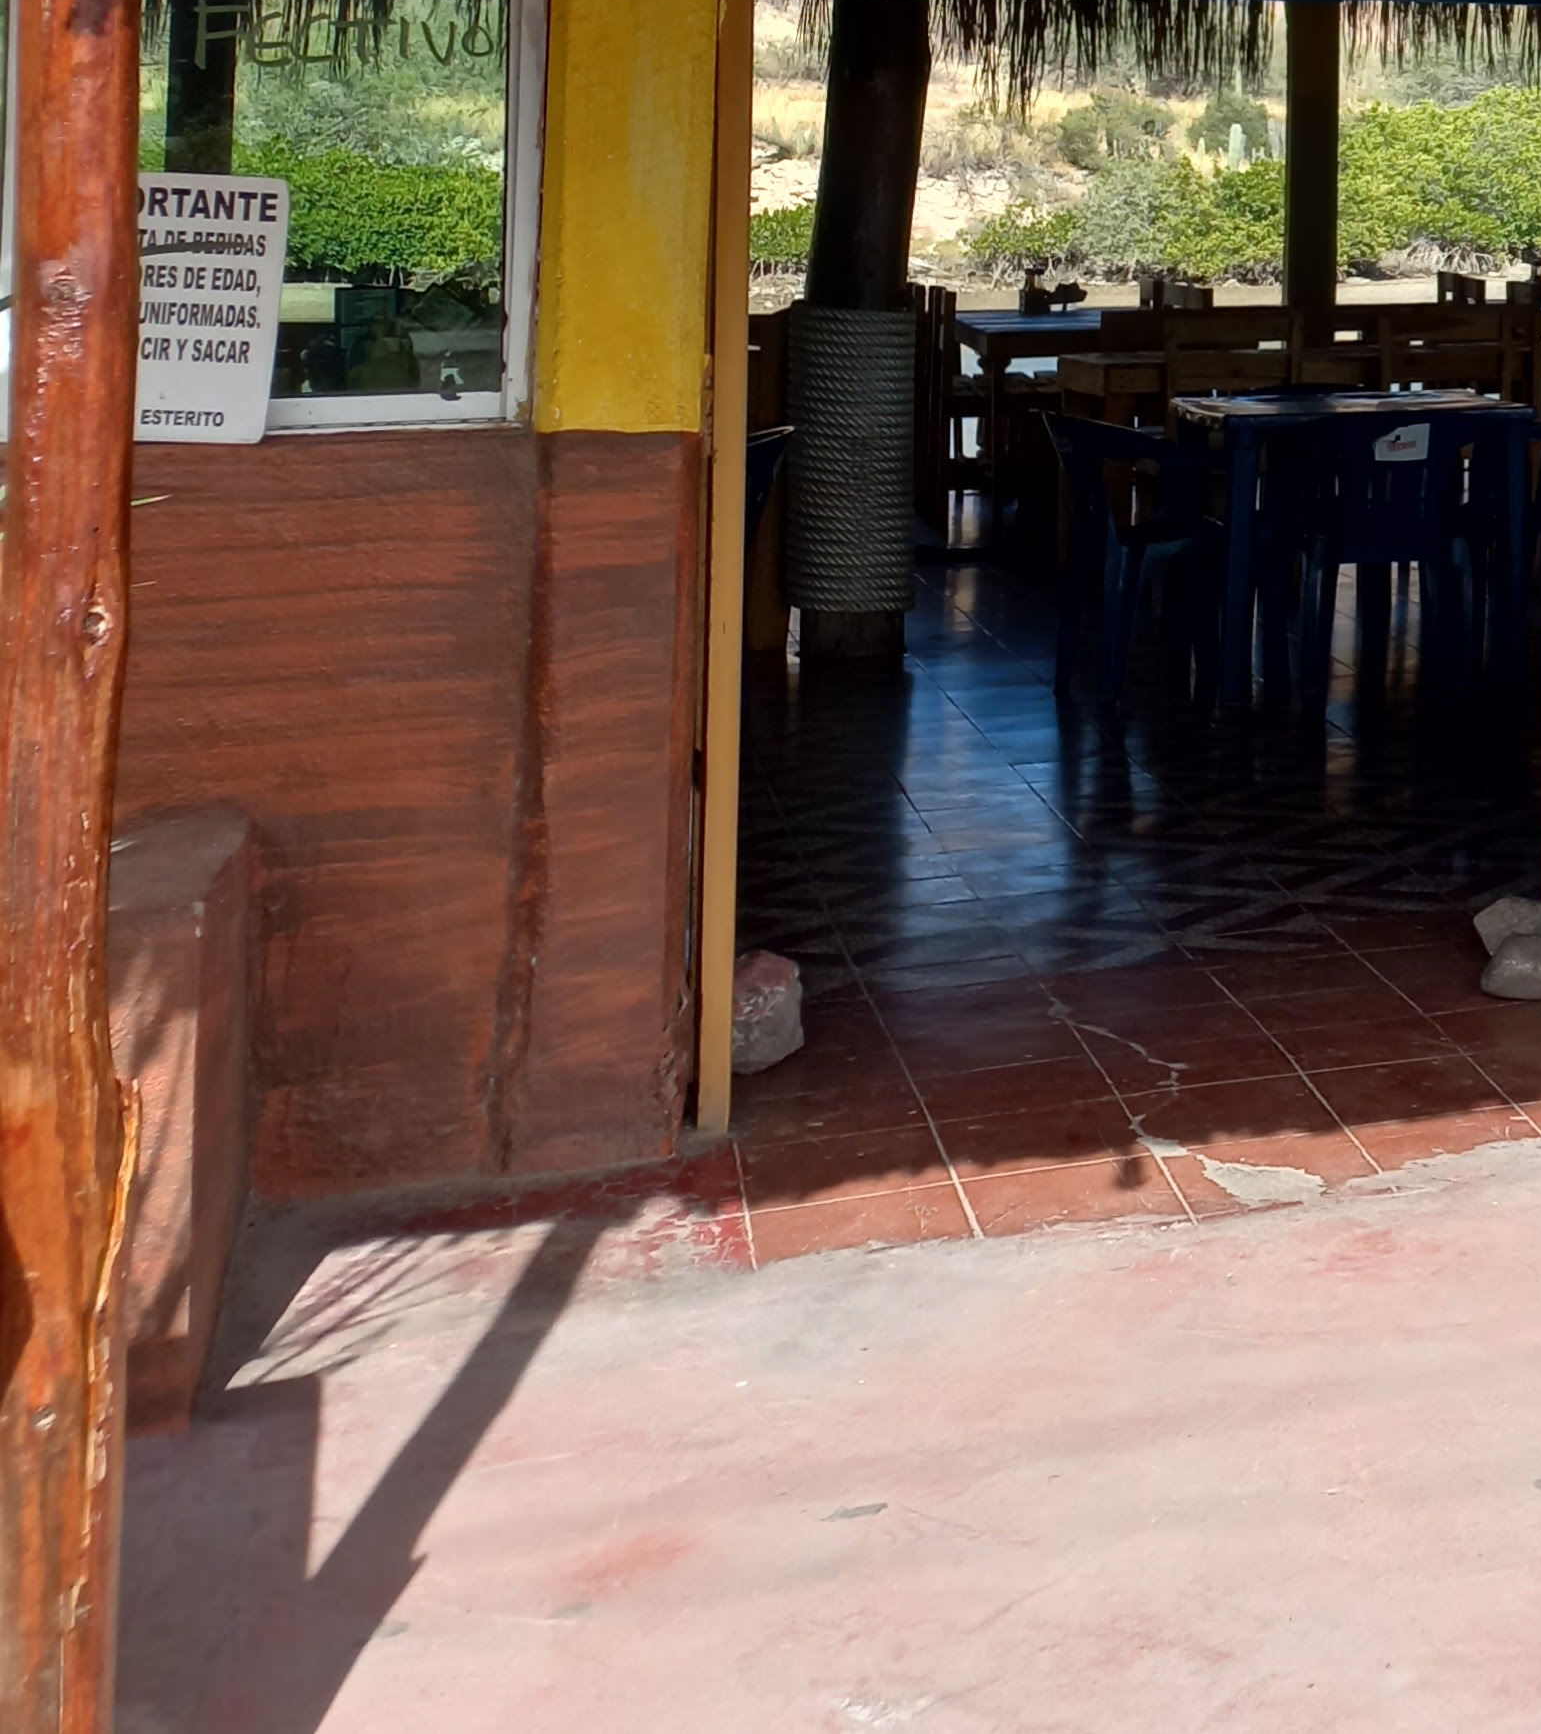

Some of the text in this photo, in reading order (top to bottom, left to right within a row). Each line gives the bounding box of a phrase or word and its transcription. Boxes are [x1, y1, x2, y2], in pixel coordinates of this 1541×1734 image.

[164, 229, 187, 250] DE
[192, 231, 266, 257] BEBIDAS
[182, 266, 207, 290] DE
[210, 267, 261, 298] EDAD,
[140, 337, 250, 364] CIR Y SACAR
[140, 409, 225, 427] ESTERITO
